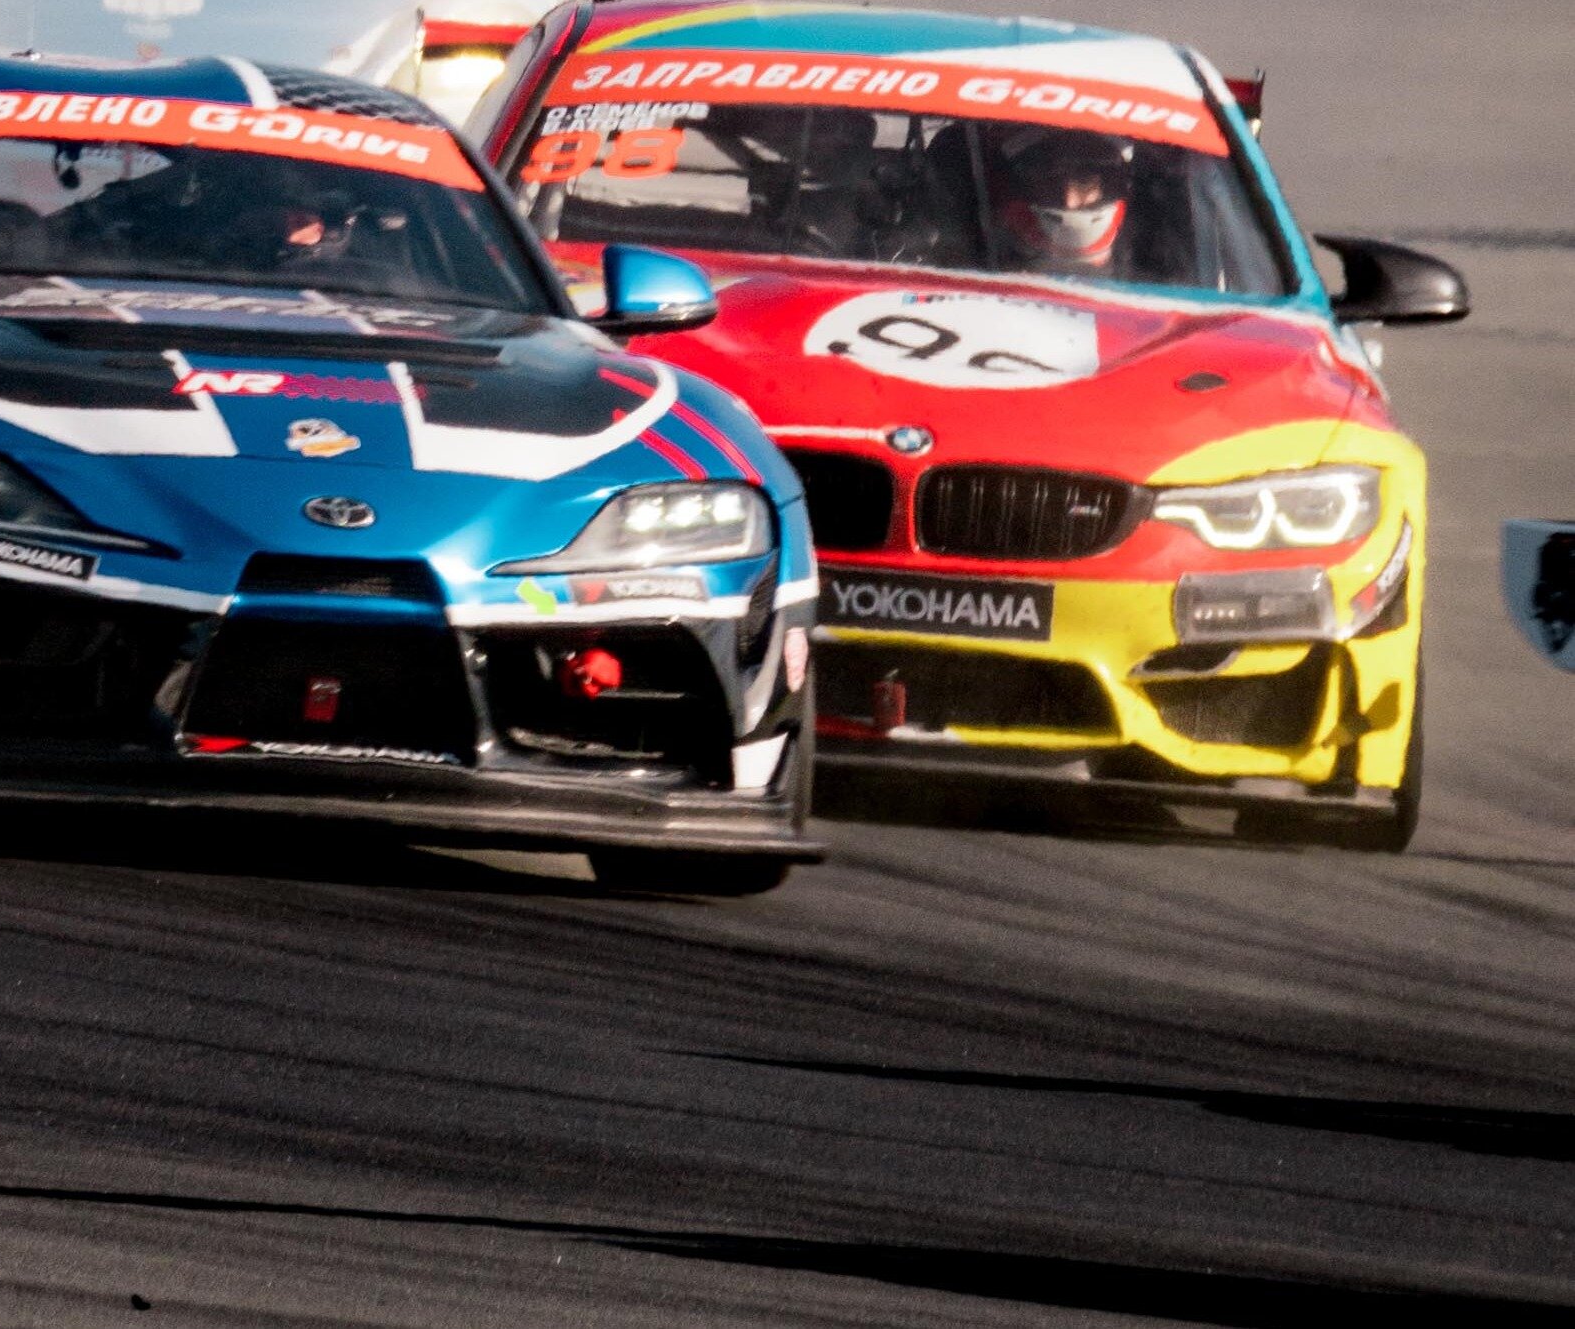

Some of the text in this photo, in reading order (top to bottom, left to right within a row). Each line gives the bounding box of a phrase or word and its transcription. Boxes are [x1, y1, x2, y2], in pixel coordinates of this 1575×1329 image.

[571, 60, 940, 97] ЗАПРАВЛЕНО
[520, 128, 684, 184] 98
[831, 581, 1041, 629] YOKOHAMA
